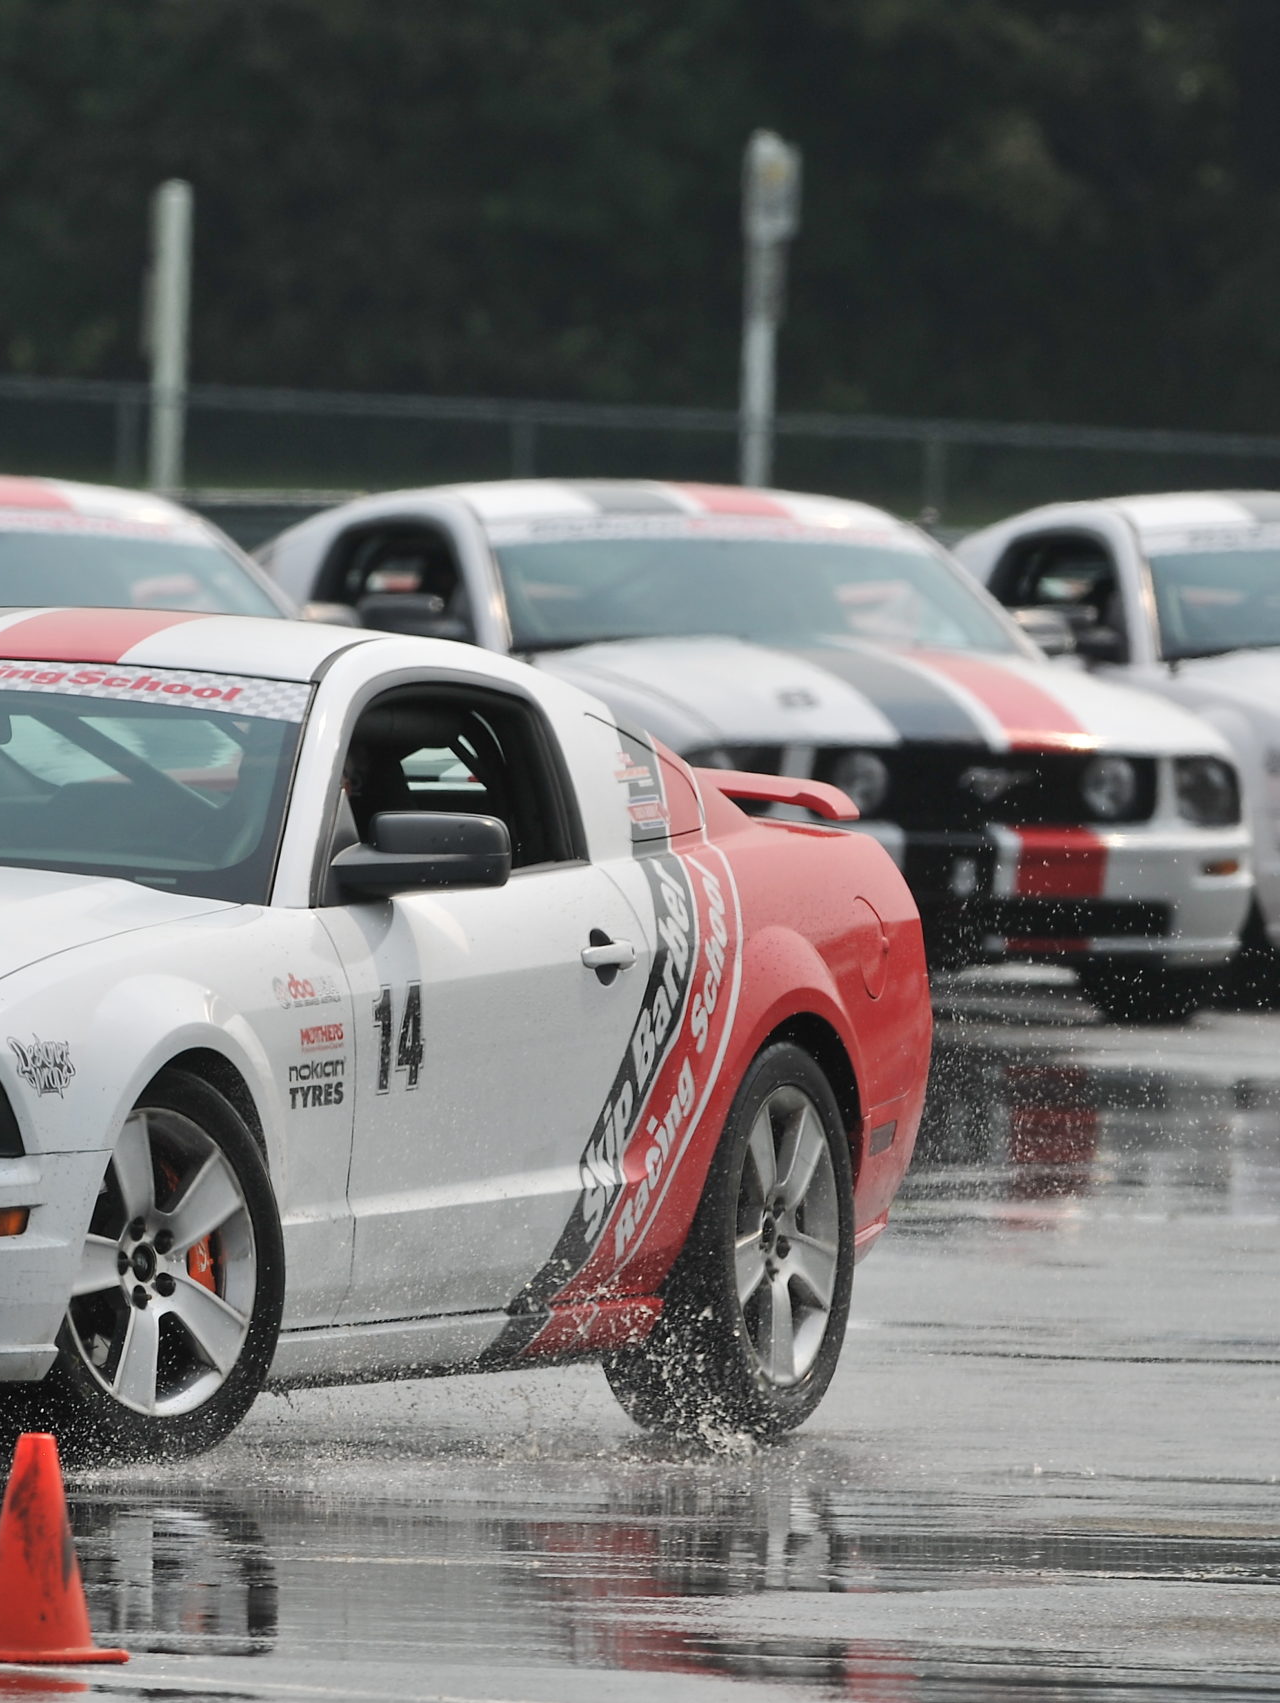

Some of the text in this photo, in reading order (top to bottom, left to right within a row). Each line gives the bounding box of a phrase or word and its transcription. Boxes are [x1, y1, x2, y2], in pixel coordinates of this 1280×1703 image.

[67, 670, 244, 702] School
[372, 979, 426, 1095] 14
[582, 1080, 634, 1243] Skip
[631, 857, 690, 1094] Barber
[614, 854, 728, 1263] Racing School
[289, 1082, 344, 1109] TYRES
